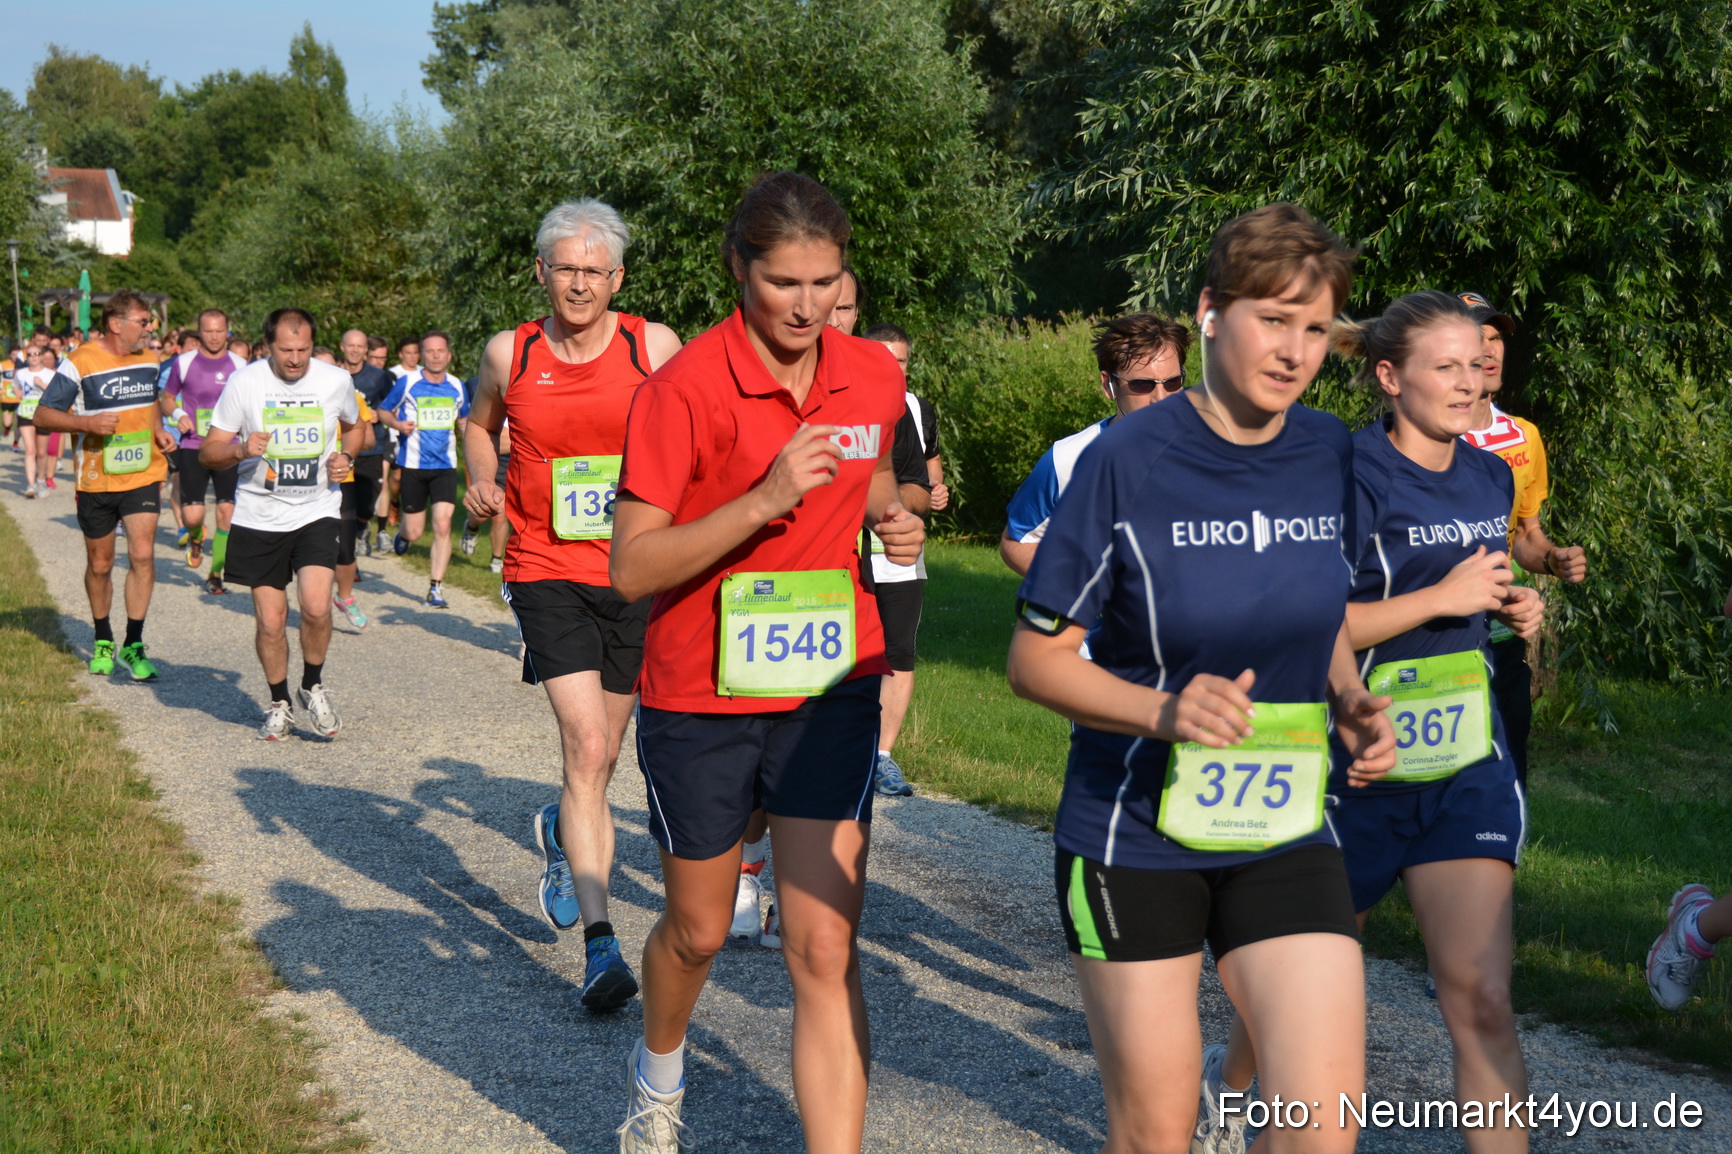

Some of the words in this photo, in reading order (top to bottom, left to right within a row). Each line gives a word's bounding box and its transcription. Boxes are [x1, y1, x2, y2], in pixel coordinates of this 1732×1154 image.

[112, 382, 154, 396] Fischer
[422, 410, 451, 421] 1123
[271, 427, 319, 444] 1156
[113, 447, 144, 462] 406
[283, 463, 310, 480] RW
[1172, 520, 1248, 546] EURO
[1274, 516, 1336, 543] POLES
[1407, 525, 1459, 546] EURO
[1468, 515, 1509, 540] POLES
[743, 592, 793, 602] firmenlauf
[737, 620, 842, 662] 1548
[1389, 678, 1433, 692] firmenlauf
[1395, 703, 1465, 749] 367
[1402, 757, 1434, 765] Corinna
[1434, 753, 1459, 763] Ziegler
[1195, 761, 1293, 809] 375
[1210, 818, 1245, 829] Andrea
[1247, 819, 1269, 830] Betz
[1475, 831, 1508, 842] adidas
